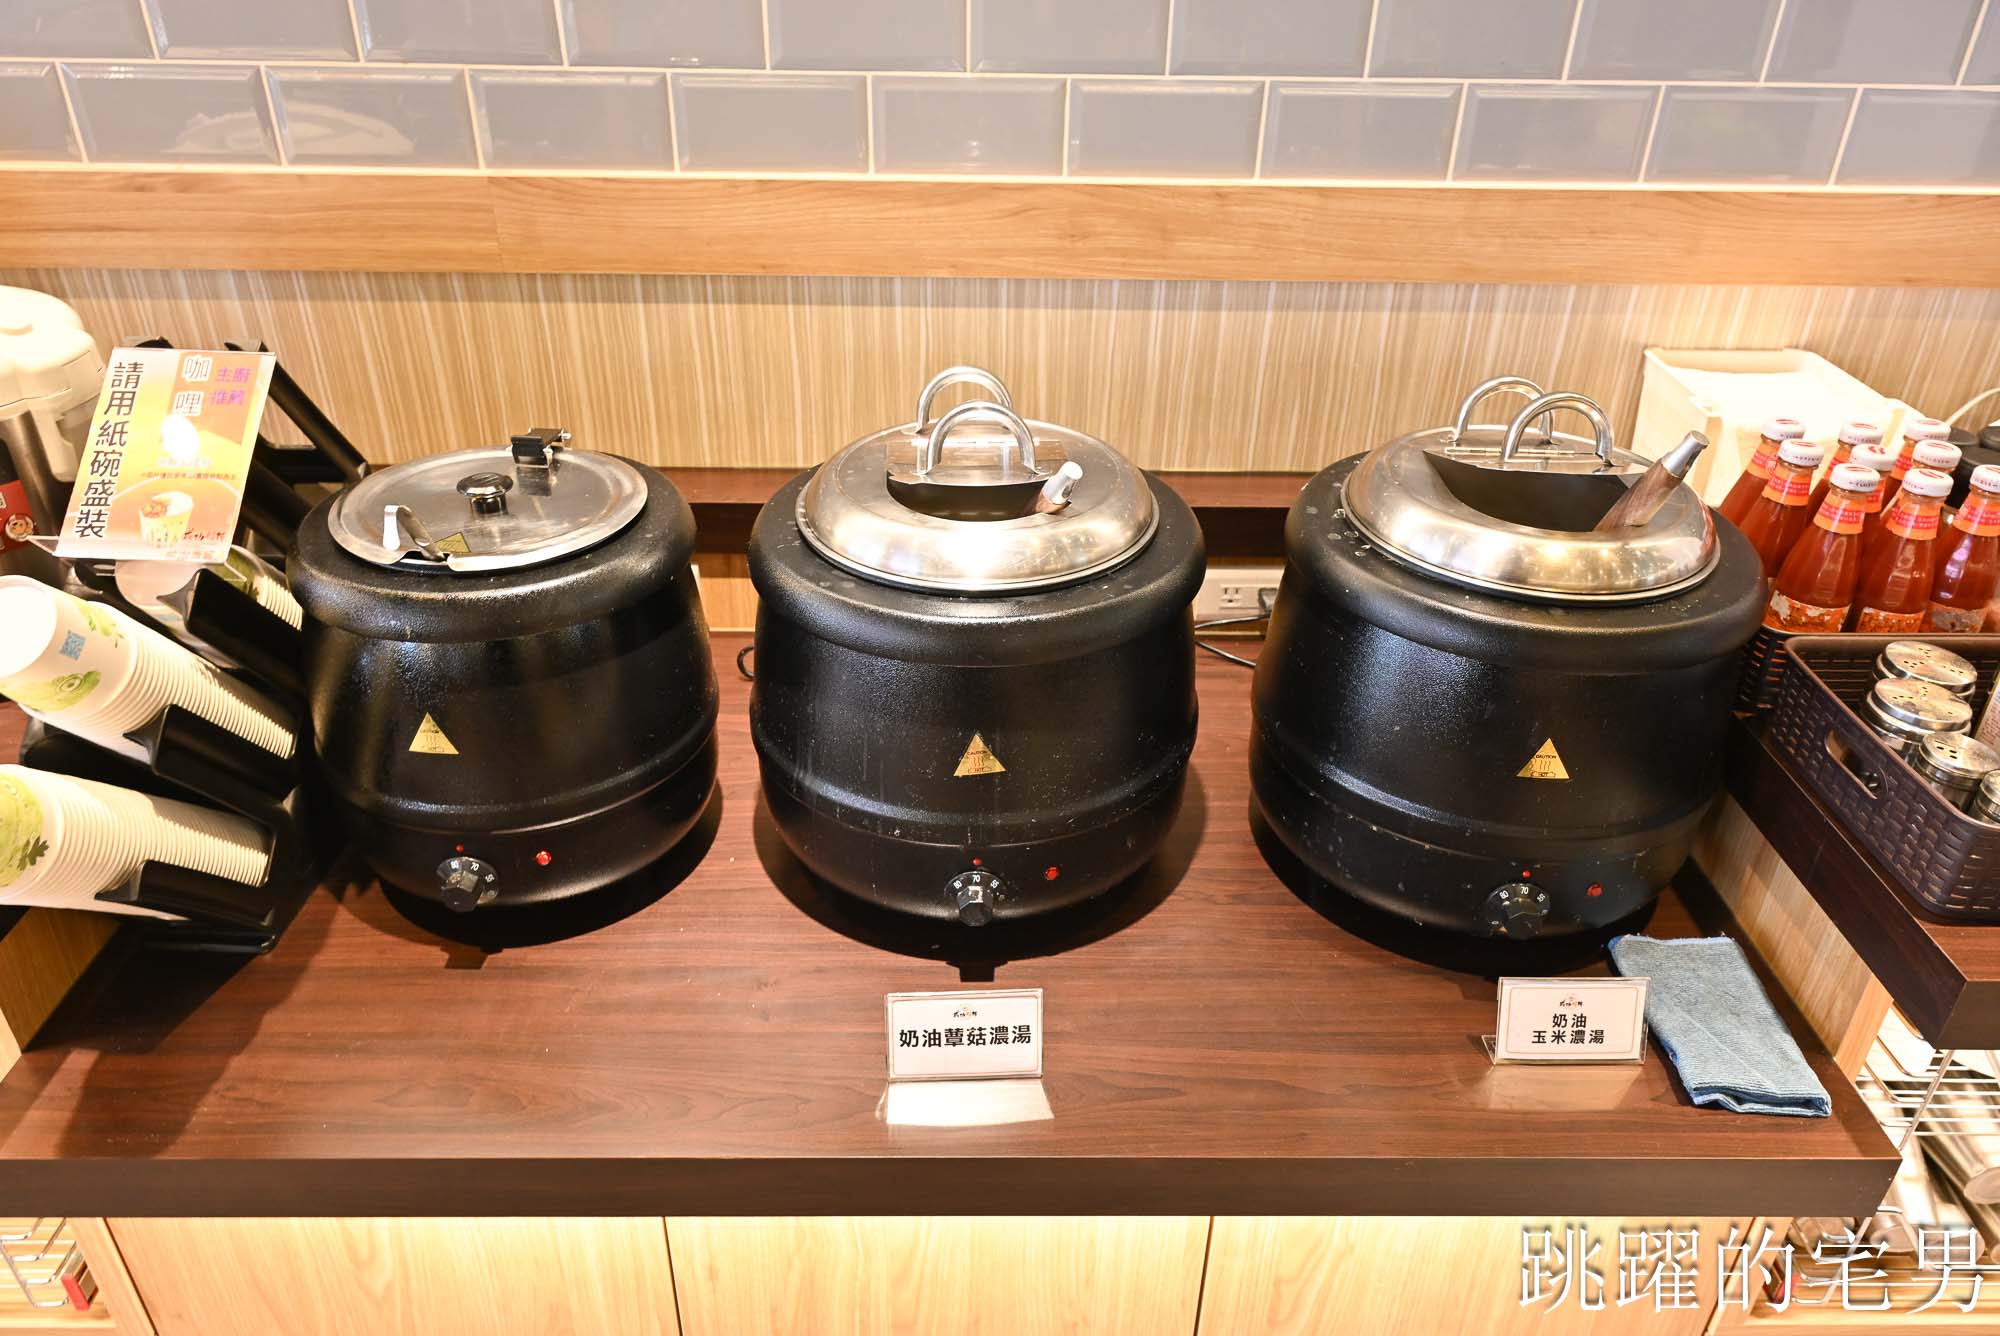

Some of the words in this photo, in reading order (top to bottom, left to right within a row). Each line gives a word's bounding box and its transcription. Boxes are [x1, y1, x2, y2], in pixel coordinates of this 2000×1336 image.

[175, 357, 210, 415] 咖哩
[75, 362, 144, 538] 請用紙碗盛裝
[470, 862, 480, 872] 70
[972, 874, 981, 883] 70
[1499, 890, 1510, 900] 80
[1520, 886, 1529, 895] 70
[1552, 1013, 1586, 1028] 奶油
[899, 1024, 1032, 1048] 奶油蕈菇濃湯
[1532, 1029, 1604, 1044] 玉米濃湯
